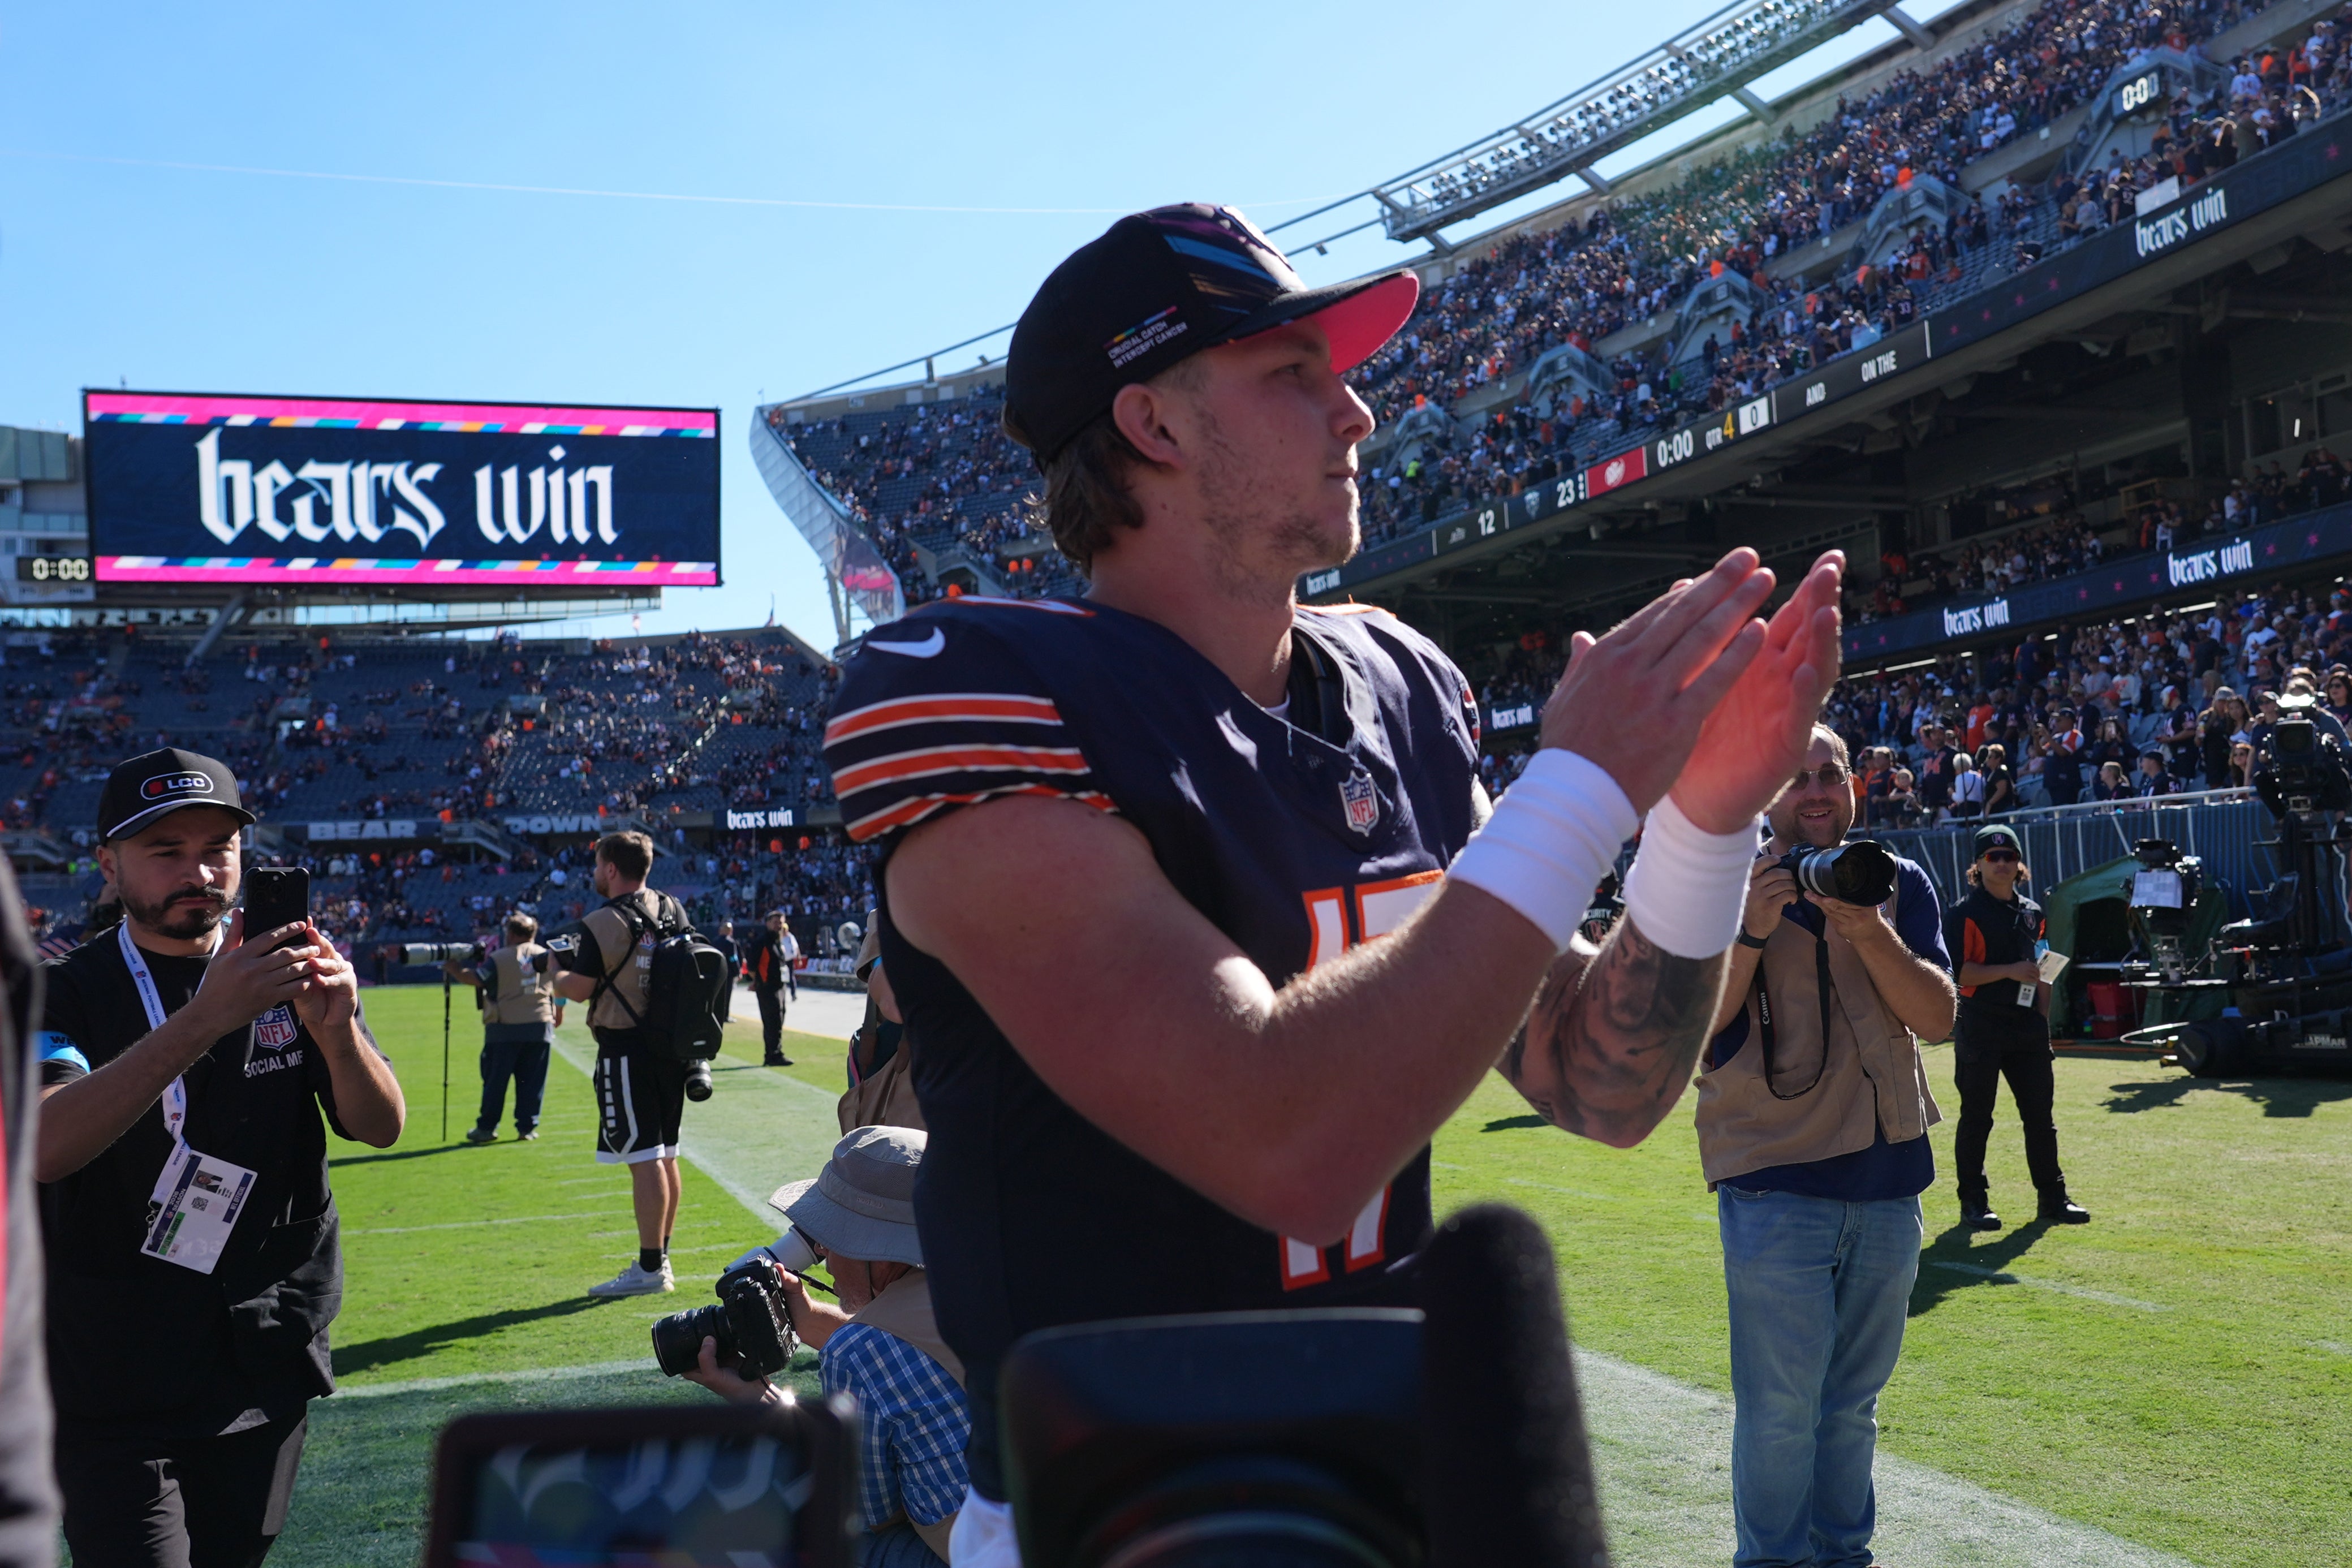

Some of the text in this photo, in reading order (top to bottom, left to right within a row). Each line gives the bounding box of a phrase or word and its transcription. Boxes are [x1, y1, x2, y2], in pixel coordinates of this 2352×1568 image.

[2135, 187, 2227, 258] bears win
[1861, 350, 1898, 382] ON THE
[1724, 411, 1735, 440] 4
[1657, 429, 1694, 467] 0:00
[195, 427, 622, 552] bears win
[1557, 478, 1575, 508] 23
[1477, 509, 1496, 536] 12
[32, 558, 89, 580] 0:00
[2168, 537, 2253, 587] bears win
[1944, 596, 2009, 637] bears win
[167, 777, 206, 789] LCC
[727, 806, 793, 830] bears win
[1350, 798, 1375, 824] NFL
[308, 820, 417, 840] BEAR
[1760, 992, 1770, 1024] Canon
[257, 1022, 292, 1044] NFL
[244, 1056, 285, 1078] SOCIAL
[172, 1188, 186, 1212] SEASON
